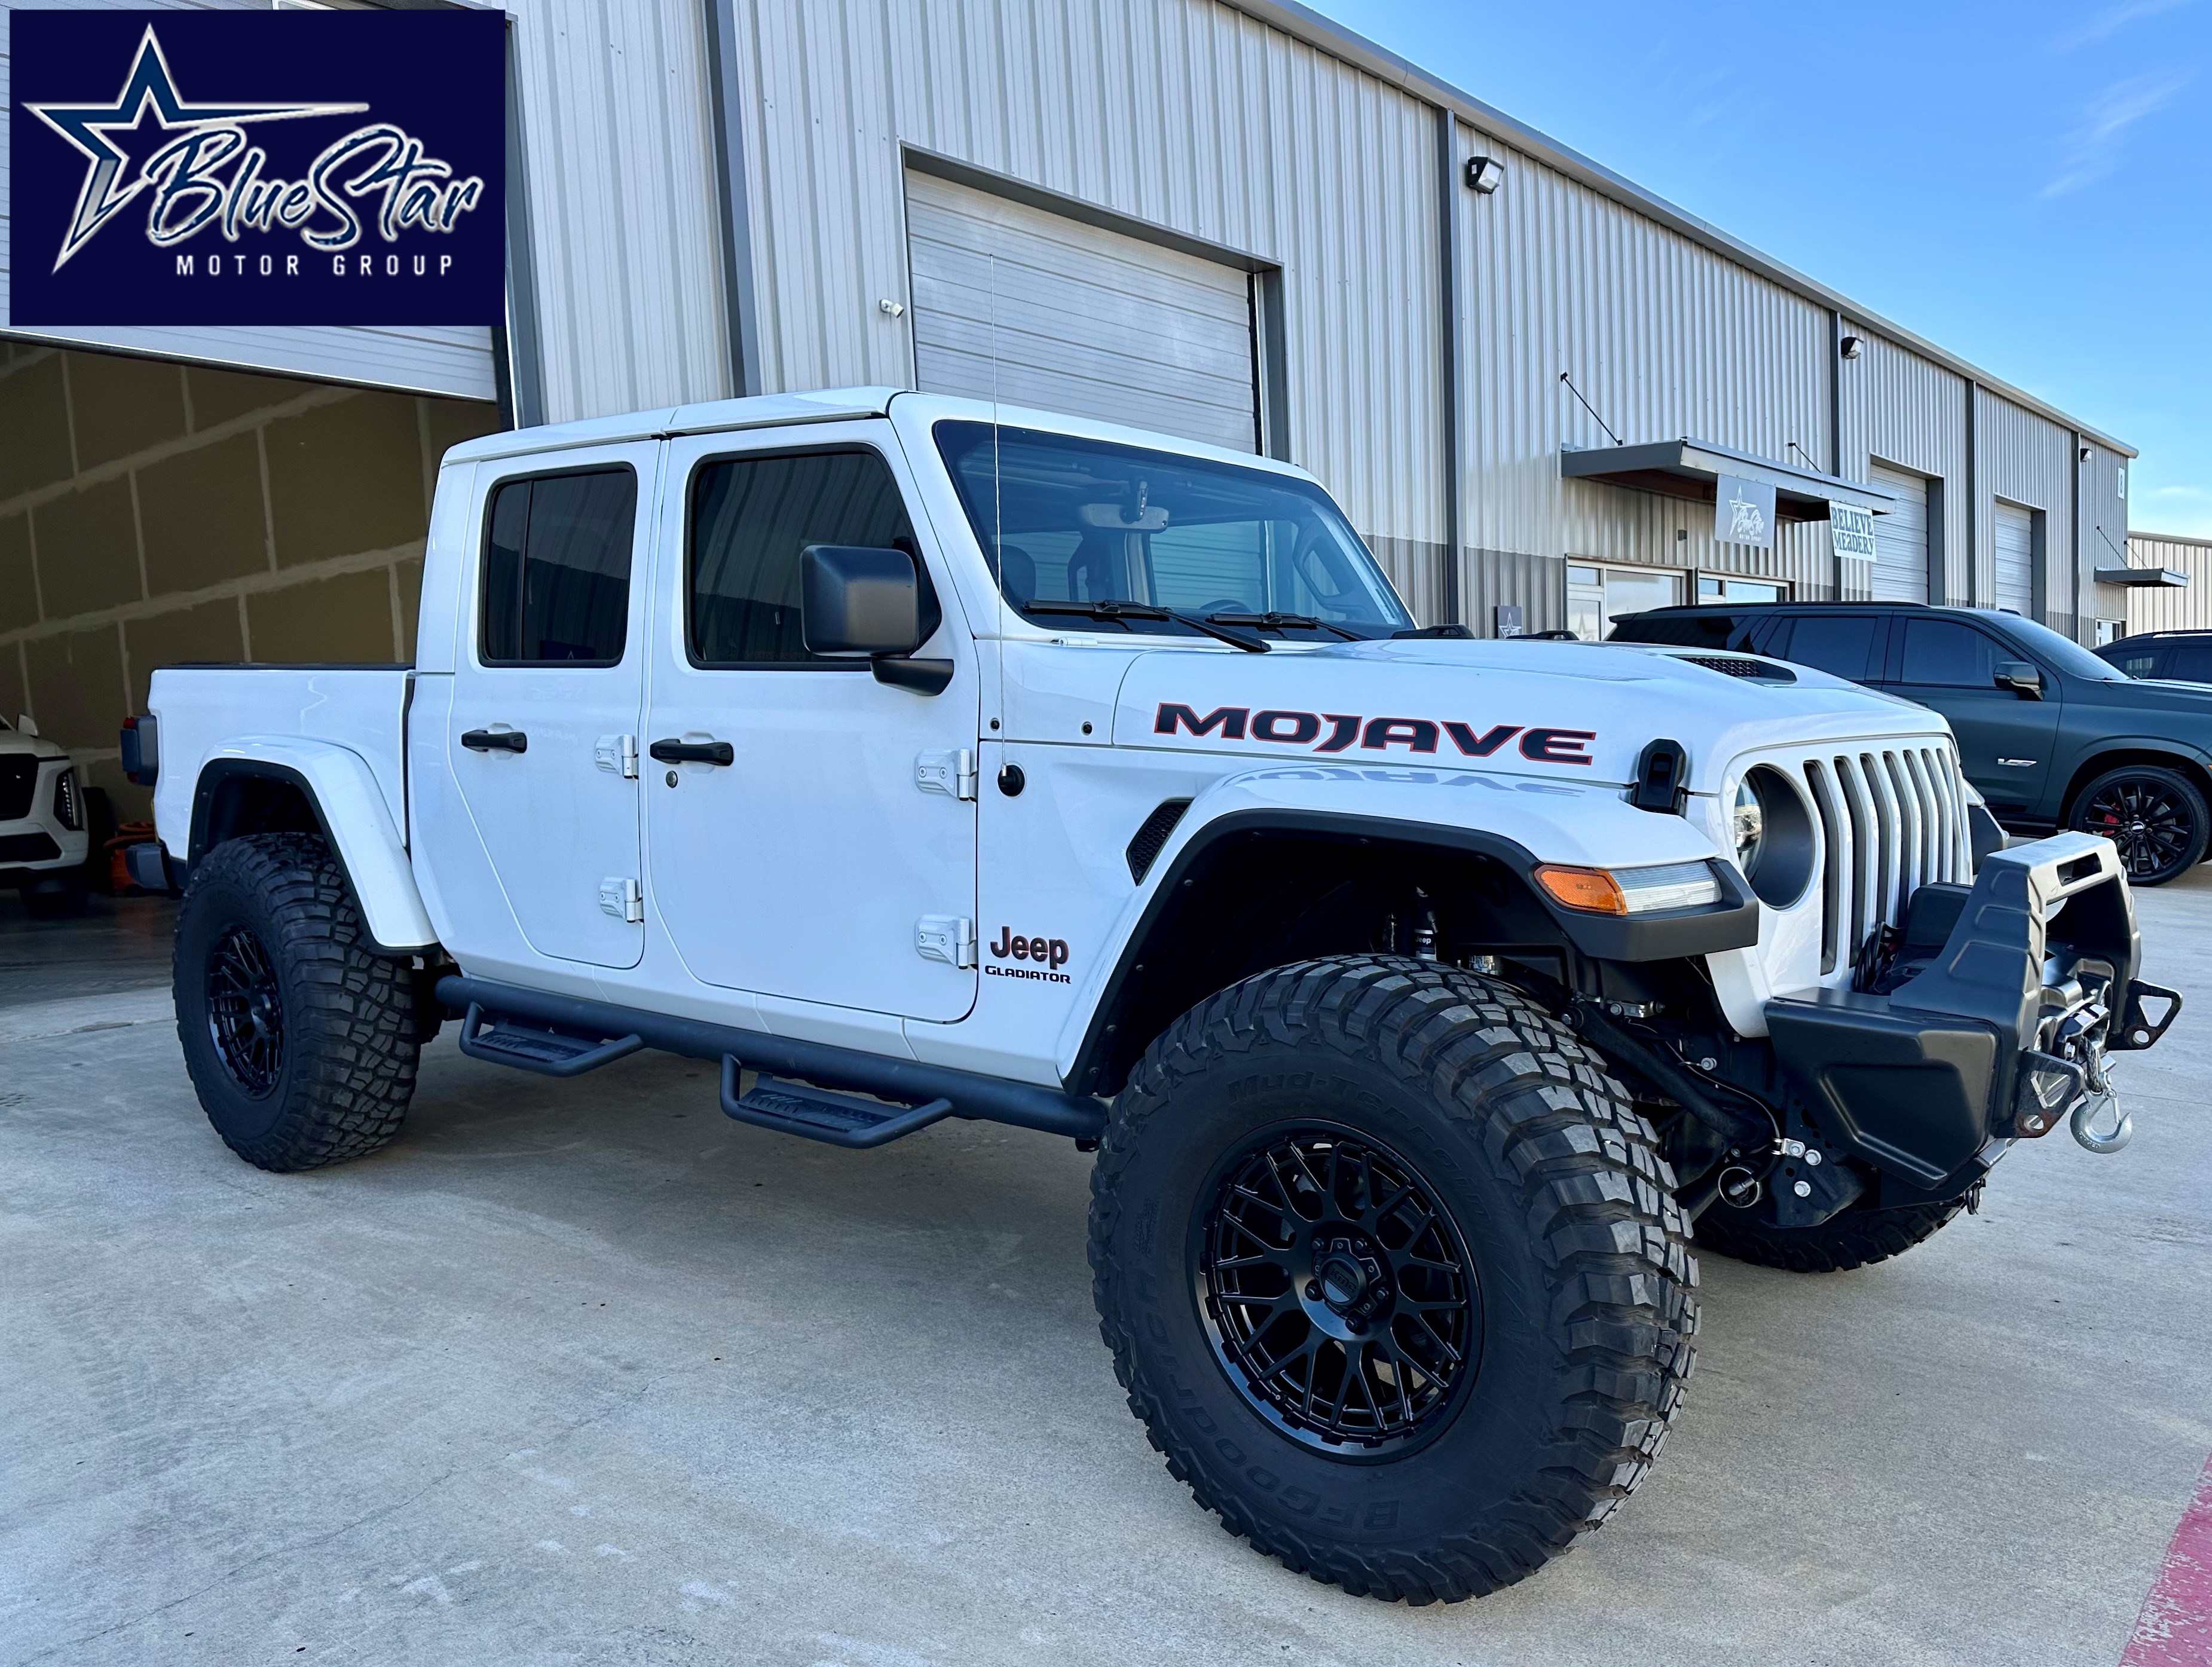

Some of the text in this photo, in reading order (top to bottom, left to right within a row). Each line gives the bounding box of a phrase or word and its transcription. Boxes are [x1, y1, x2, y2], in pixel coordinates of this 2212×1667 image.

[1830, 506, 1874, 536] BELIEVE
[1154, 702, 1598, 766] MOJAVE
[990, 926, 1069, 970] Jeep
[1415, 935, 1431, 945] Jeep
[985, 965, 1072, 984] GLADIATOR
